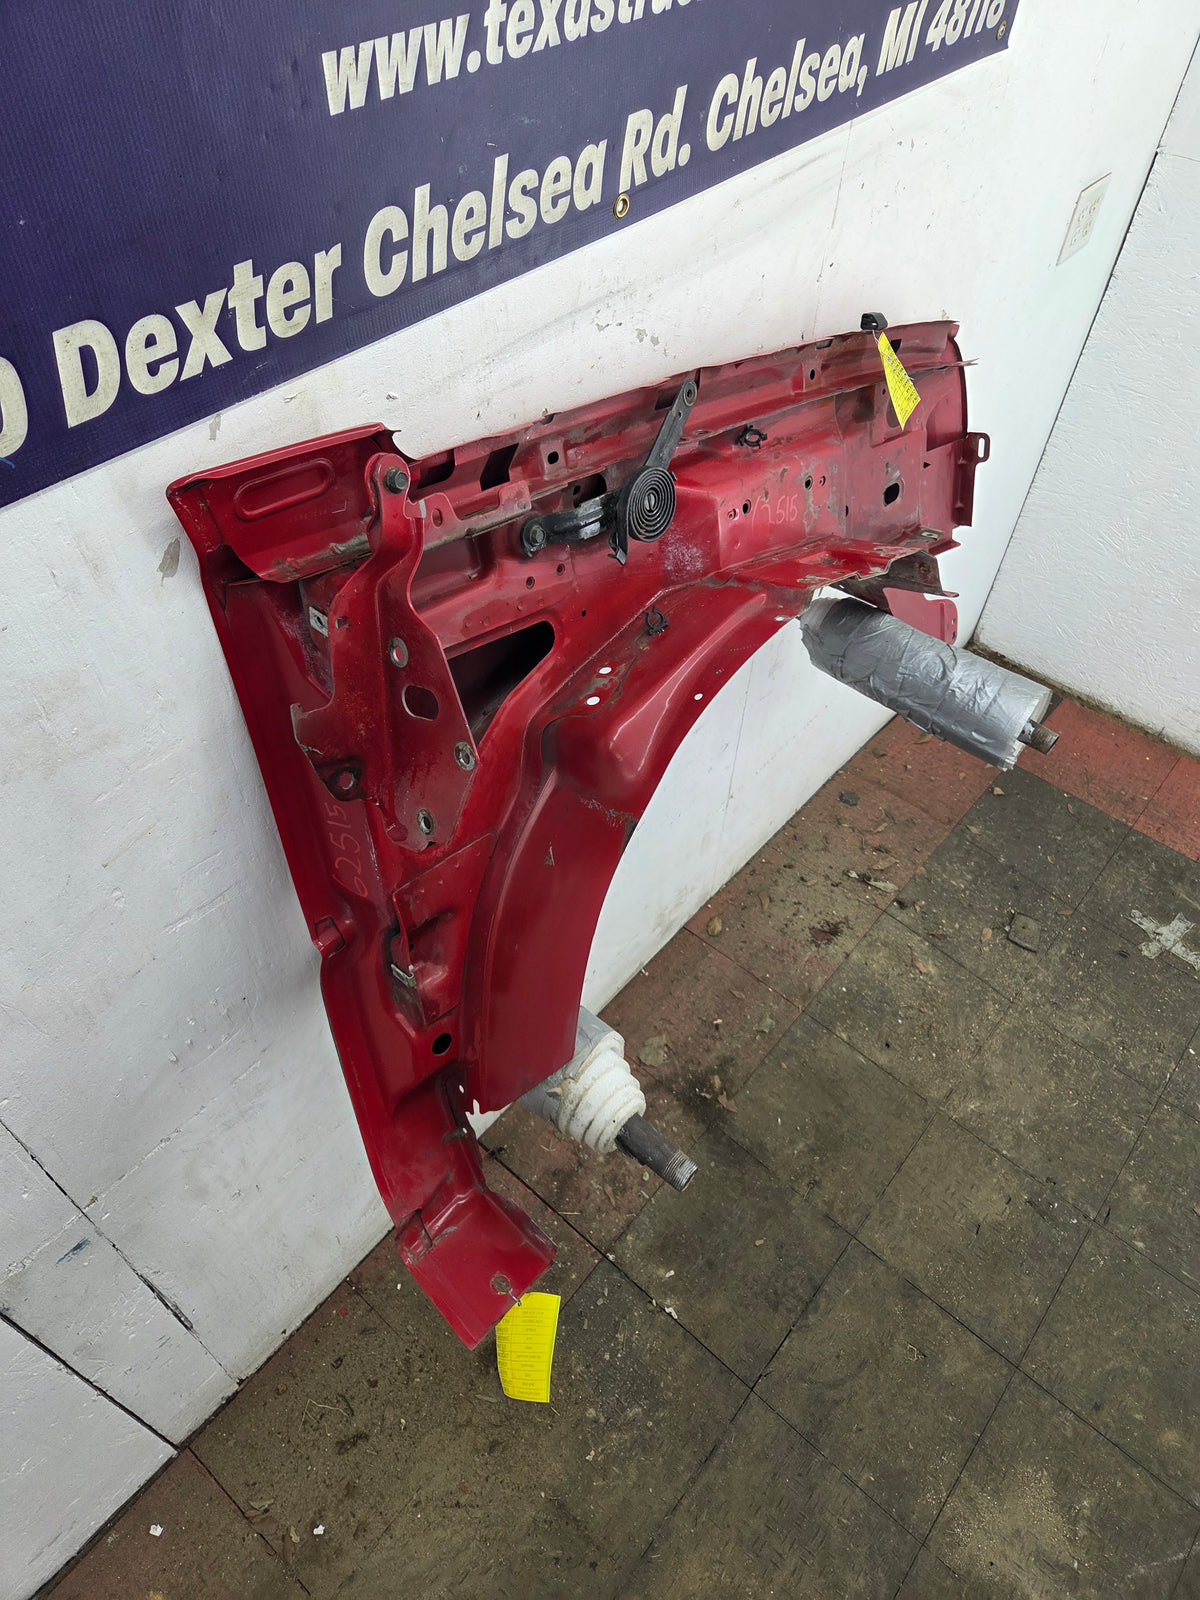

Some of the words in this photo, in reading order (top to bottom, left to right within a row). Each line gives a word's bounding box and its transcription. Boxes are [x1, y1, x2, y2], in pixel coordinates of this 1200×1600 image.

[53, 242, 342, 428] Dexter
[363, 138, 608, 297] Chelsea
[618, 84, 691, 195] Rd.
[705, 32, 868, 152] Chelsea,
[875, 0, 929, 77] MI
[324, 801, 369, 899] 62515
